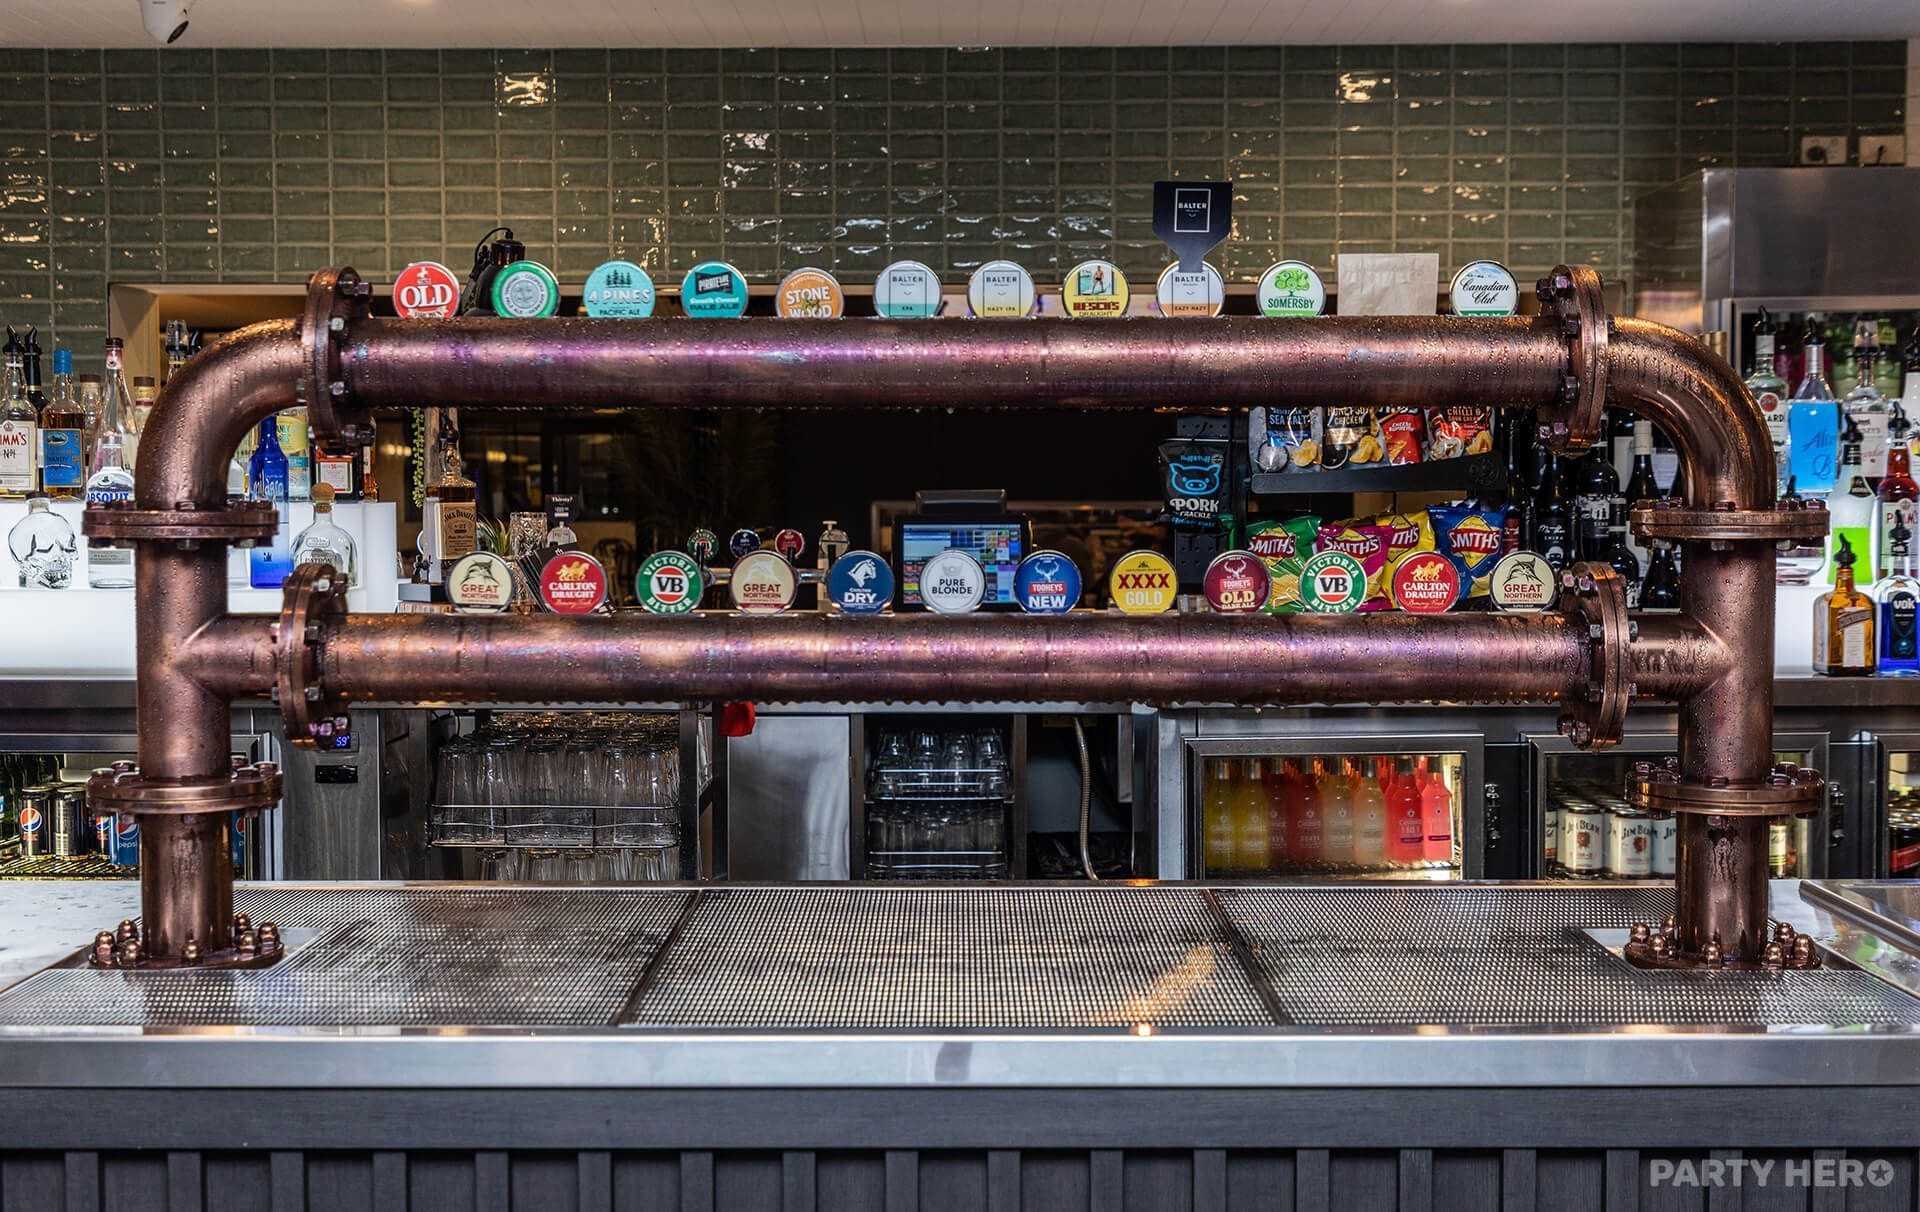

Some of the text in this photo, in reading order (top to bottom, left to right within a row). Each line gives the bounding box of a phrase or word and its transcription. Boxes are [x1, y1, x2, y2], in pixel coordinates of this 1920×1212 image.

[1460, 278, 1509, 291] Canadian
[401, 284, 453, 308] OLD
[588, 288, 651, 304] 4 PINES
[786, 286, 831, 305] STONE
[1472, 290, 1499, 304] Club
[1268, 297, 1315, 309] SOMERSBY
[789, 304, 832, 318] WOOD
[1447, 407, 1473, 416] CHILLI
[1269, 415, 1287, 425] SEA
[1334, 416, 1363, 425] CHICKEN
[1169, 498, 1220, 513] PORK
[1180, 511, 1212, 519] CRACKLE
[1392, 526, 1419, 545] ITH'S
[1450, 532, 1500, 550] SMITH'S
[1248, 535, 1295, 555] SMITH'S
[1323, 534, 1379, 555] SMITH'S
[643, 556, 697, 579] VICTORIA
[1307, 556, 1360, 578] VICTORIA
[549, 582, 597, 591] CARLTON
[656, 576, 684, 592] VB
[743, 584, 782, 592] GREAT
[1032, 583, 1064, 592] TOOHEYS
[1118, 573, 1170, 589] XXXX
[1320, 577, 1348, 593] VB
[1403, 581, 1450, 591] CARLTON
[1504, 584, 1543, 592] GREAT
[461, 584, 499, 593] GREAT
[551, 591, 595, 599] DRAUGHT
[932, 586, 973, 595] BLONDE
[1405, 591, 1449, 599] DRAUGHT
[844, 592, 878, 604] DRY
[1028, 595, 1066, 609] NEW
[1126, 590, 1163, 606] GOLD
[1220, 590, 1256, 604] OLD
[1893, 597, 1916, 610] vok
[646, 596, 693, 613] BITTER
[1311, 596, 1358, 613] BITTER
[1579, 819, 1600, 834] BEAM
[1621, 824, 1636, 840] JIM
[118, 841, 138, 851] pepsi
